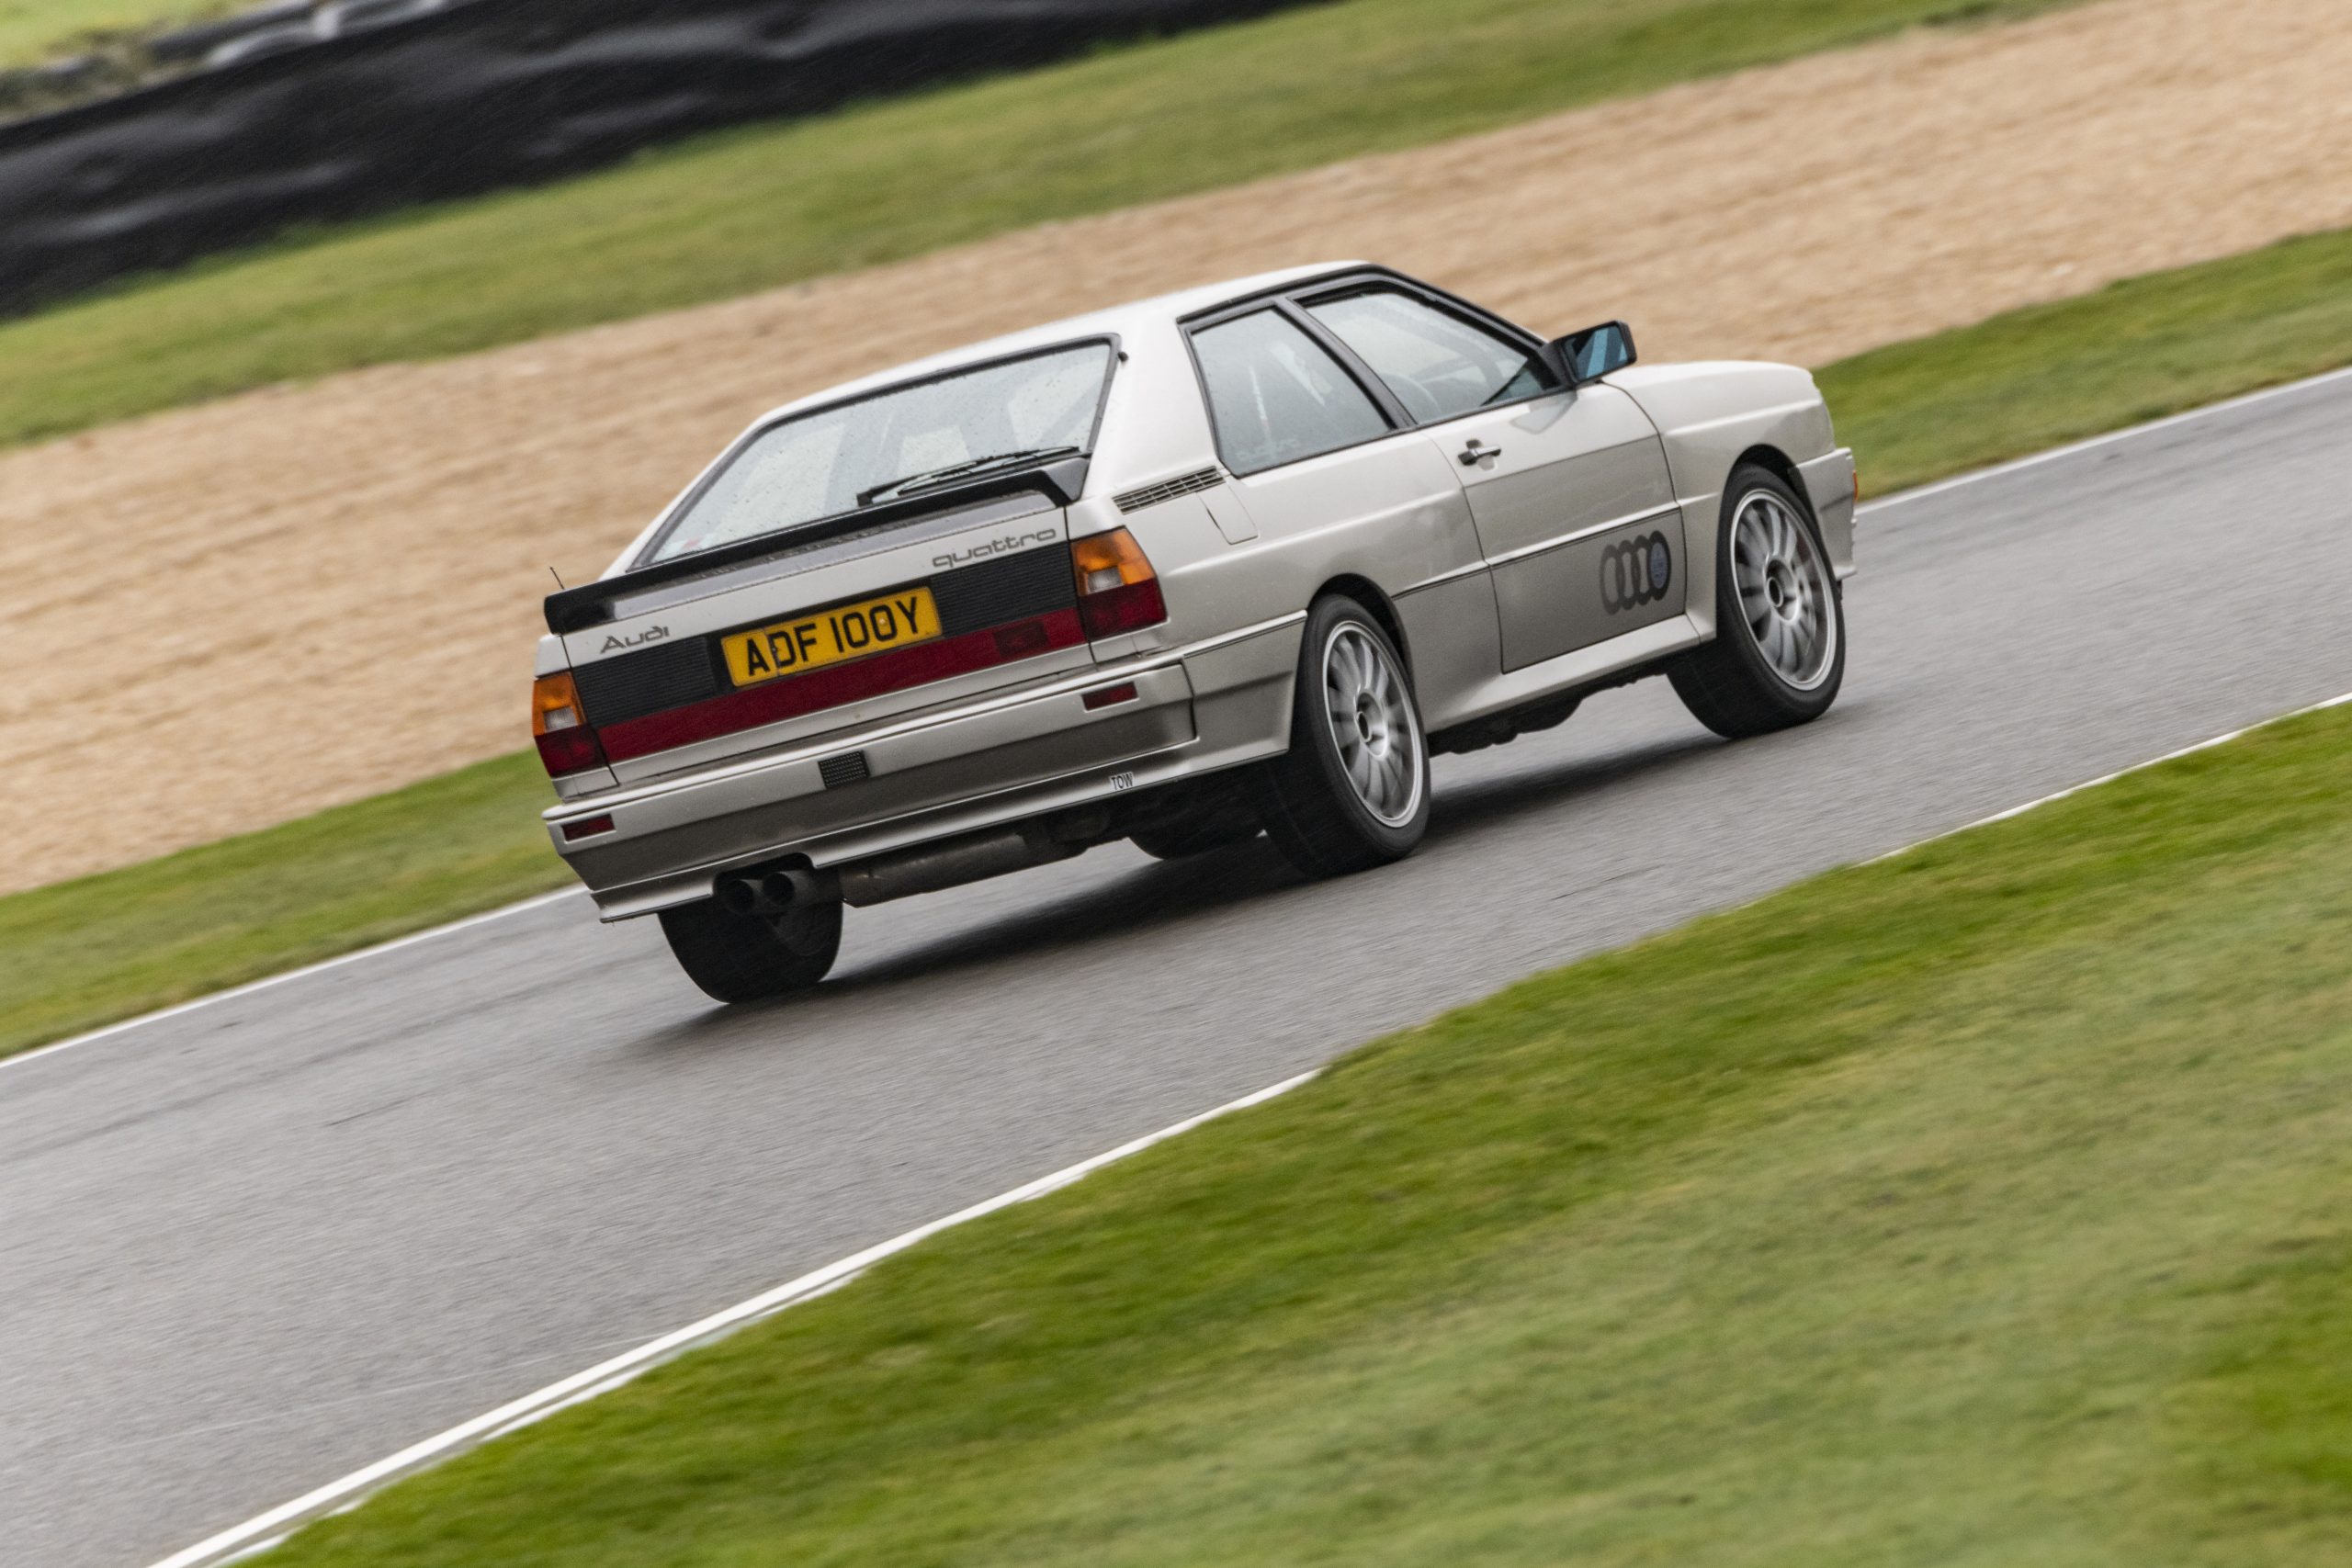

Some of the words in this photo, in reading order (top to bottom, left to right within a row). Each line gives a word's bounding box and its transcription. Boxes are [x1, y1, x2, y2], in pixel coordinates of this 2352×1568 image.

[932, 528, 1057, 568] quattro
[600, 626, 670, 654] Audi
[746, 623, 818, 676] ADF
[830, 596, 918, 653] 100Y
[1111, 773, 1133, 790] TOW
